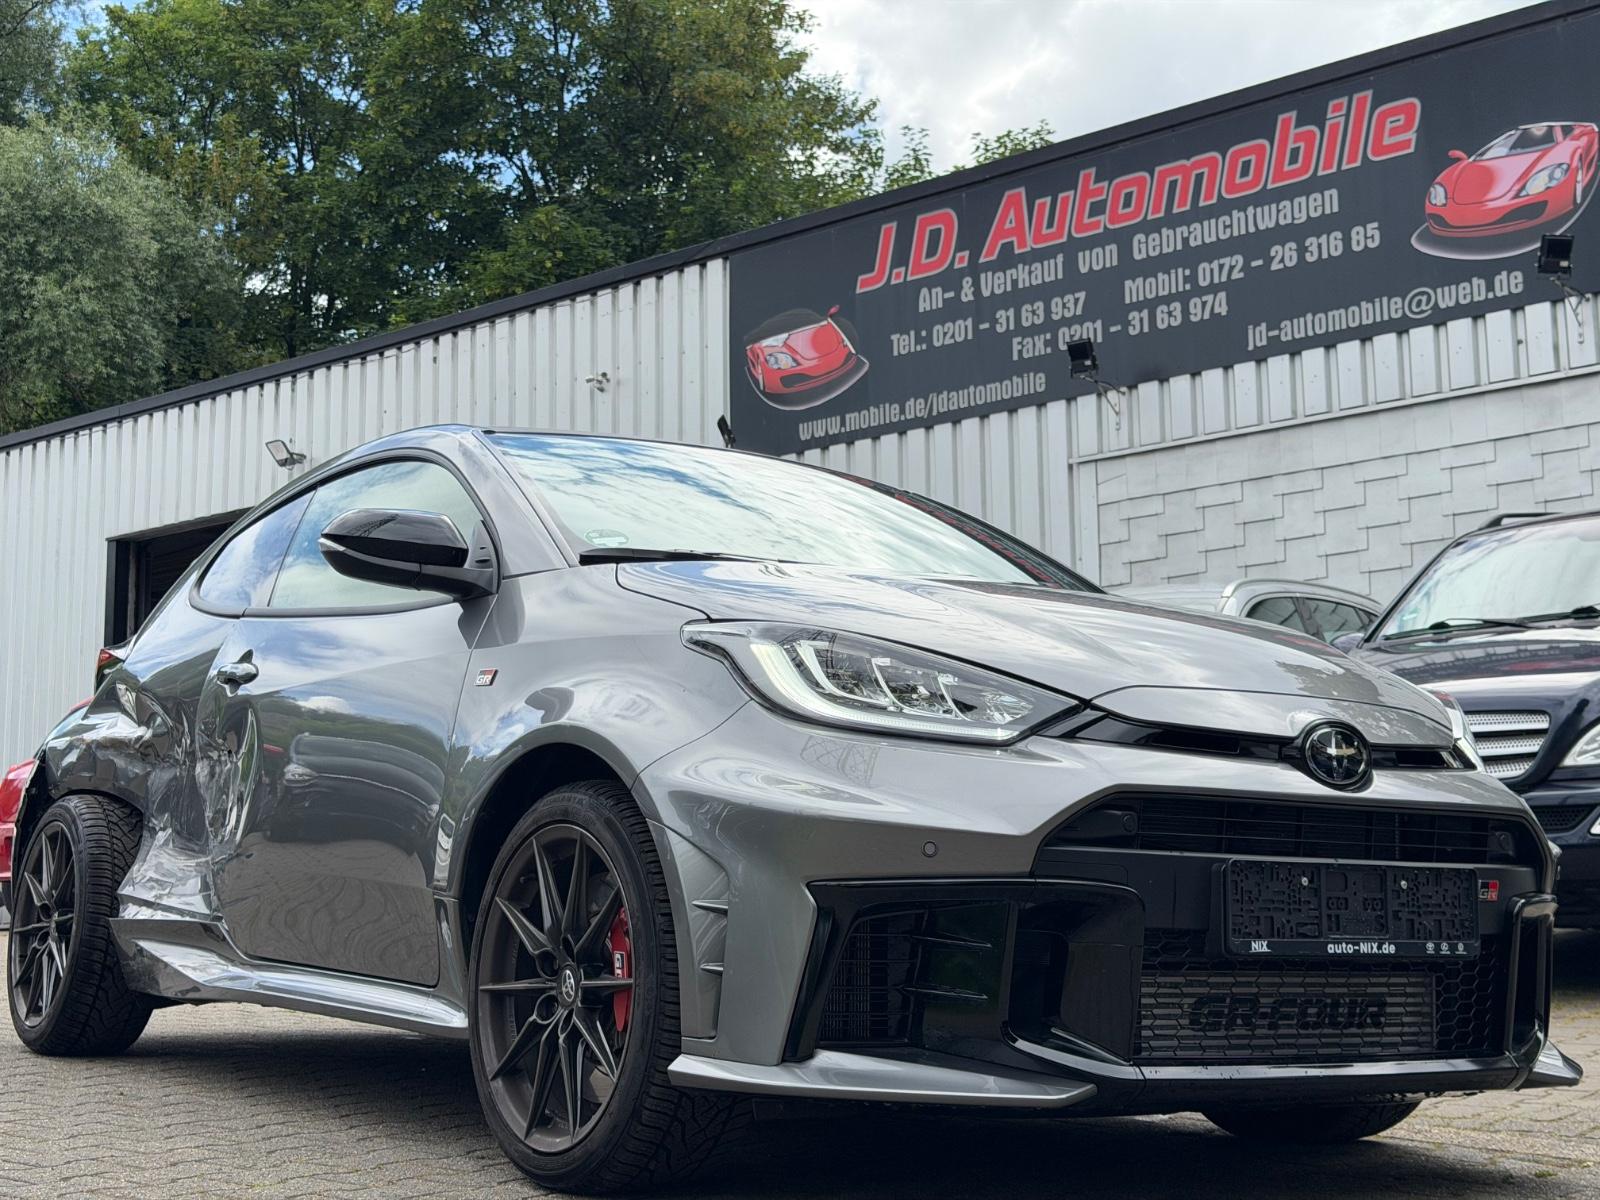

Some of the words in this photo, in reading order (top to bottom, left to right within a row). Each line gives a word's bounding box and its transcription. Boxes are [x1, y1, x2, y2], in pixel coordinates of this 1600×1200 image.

[856, 208, 969, 294] J.D.
[978, 89, 1421, 263] Automobile
[918, 287, 955, 313] An-
[960, 277, 975, 302] &
[980, 253, 1065, 298] Verkauf
[1078, 243, 1119, 273] von
[1132, 188, 1339, 261] Gebrauchtwagen
[1124, 266, 1191, 304] Mobil:
[1198, 254, 1245, 287] 0172
[1270, 242, 1298, 271] 26
[1304, 230, 1343, 263] 316
[1350, 222, 1382, 250] 85
[890, 329, 927, 357] Tel.:
[932, 318, 974, 349] 0201
[995, 308, 1015, 333] 31
[1021, 301, 1045, 327] 63
[1050, 291, 1086, 321] 937
[1012, 333, 1051, 361] Fax:
[1128, 309, 1150, 336] 31
[1156, 302, 1182, 330] 63
[1189, 291, 1228, 322] 974
[1247, 270, 1524, 351] jd-automobile@web.de
[799, 372, 1046, 441] www.mobile.de/jdautomobile
[1251, 941, 1268, 951] NIX
[1327, 942, 1396, 954] auto-NIX.de
